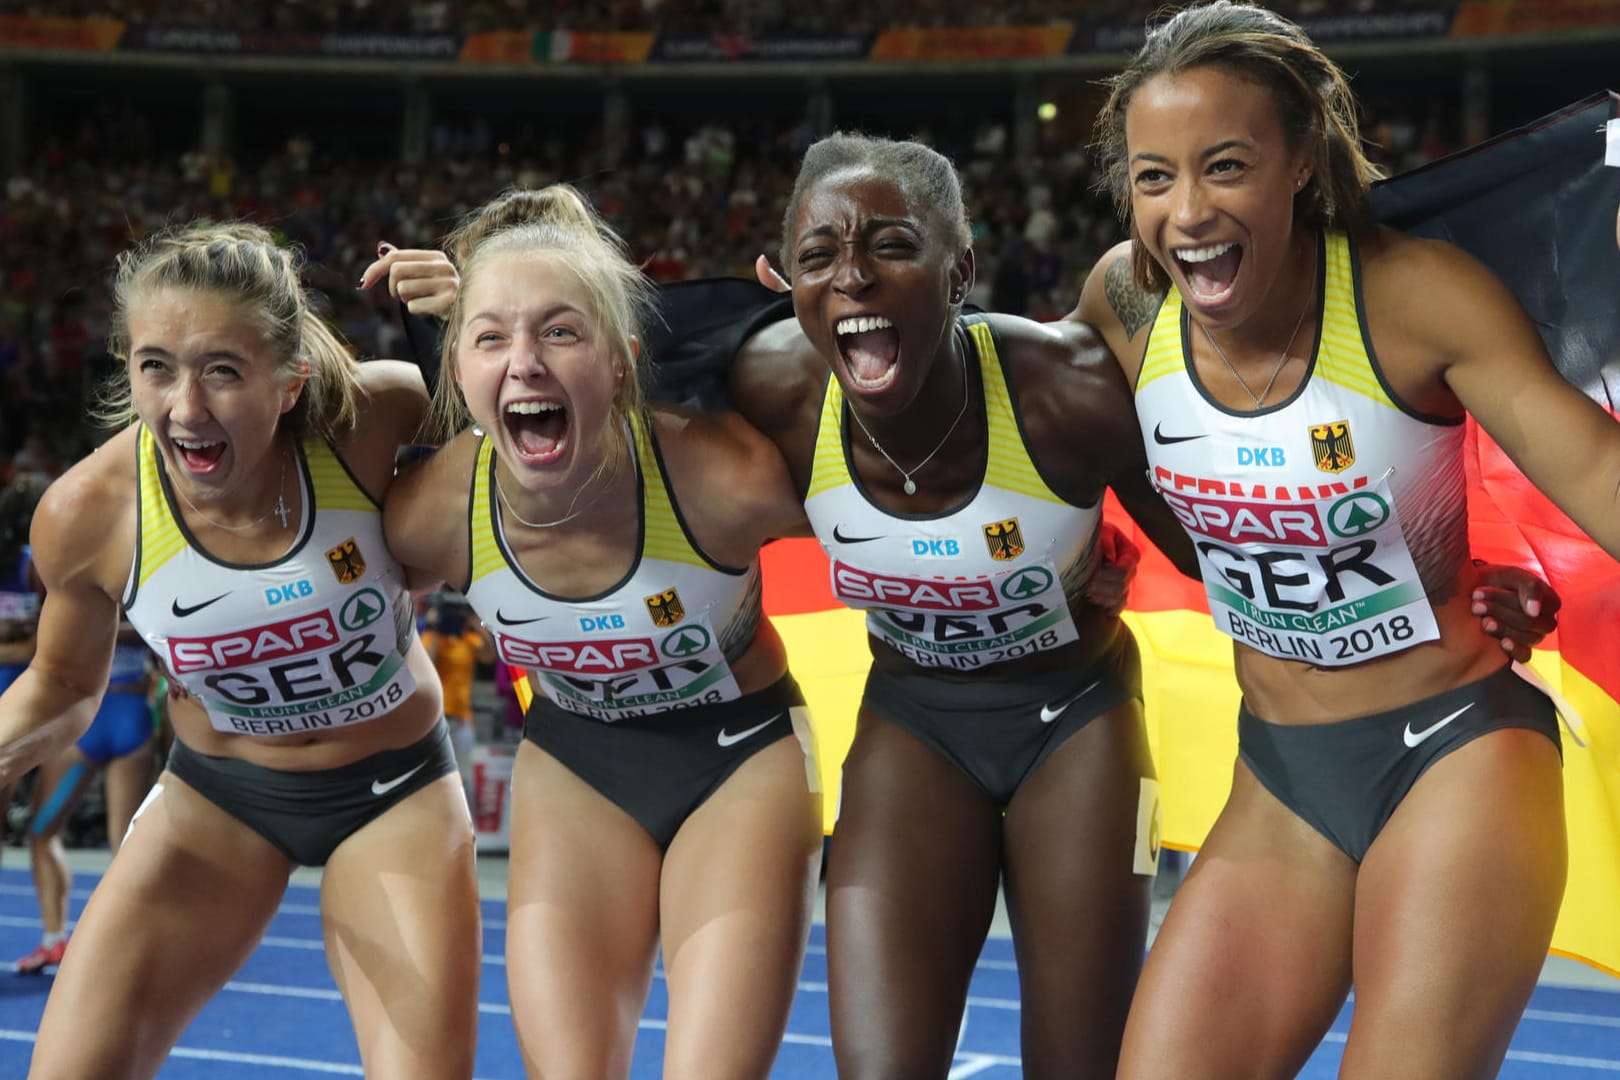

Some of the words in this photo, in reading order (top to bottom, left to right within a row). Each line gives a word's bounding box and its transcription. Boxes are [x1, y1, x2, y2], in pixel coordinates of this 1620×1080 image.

[1237, 447, 1286, 467] DKB
[1162, 493, 1321, 542] SPAR
[912, 539, 960, 556] DKB
[837, 568, 993, 607] SPAR
[1197, 538, 1397, 613] GER
[265, 579, 314, 606] DKB
[580, 614, 626, 633] DKB
[1251, 605, 1287, 629] RUN
[174, 616, 334, 671] SPAR
[988, 630, 1059, 662] 2018
[1228, 611, 1324, 660] BERLIN
[1329, 615, 1415, 660] 2018
[204, 634, 385, 706] GER
[503, 639, 655, 670] SPAR
[230, 712, 332, 735] BERLIN
[339, 682, 403, 723] 2018
[261, 706, 300, 718] RUN
